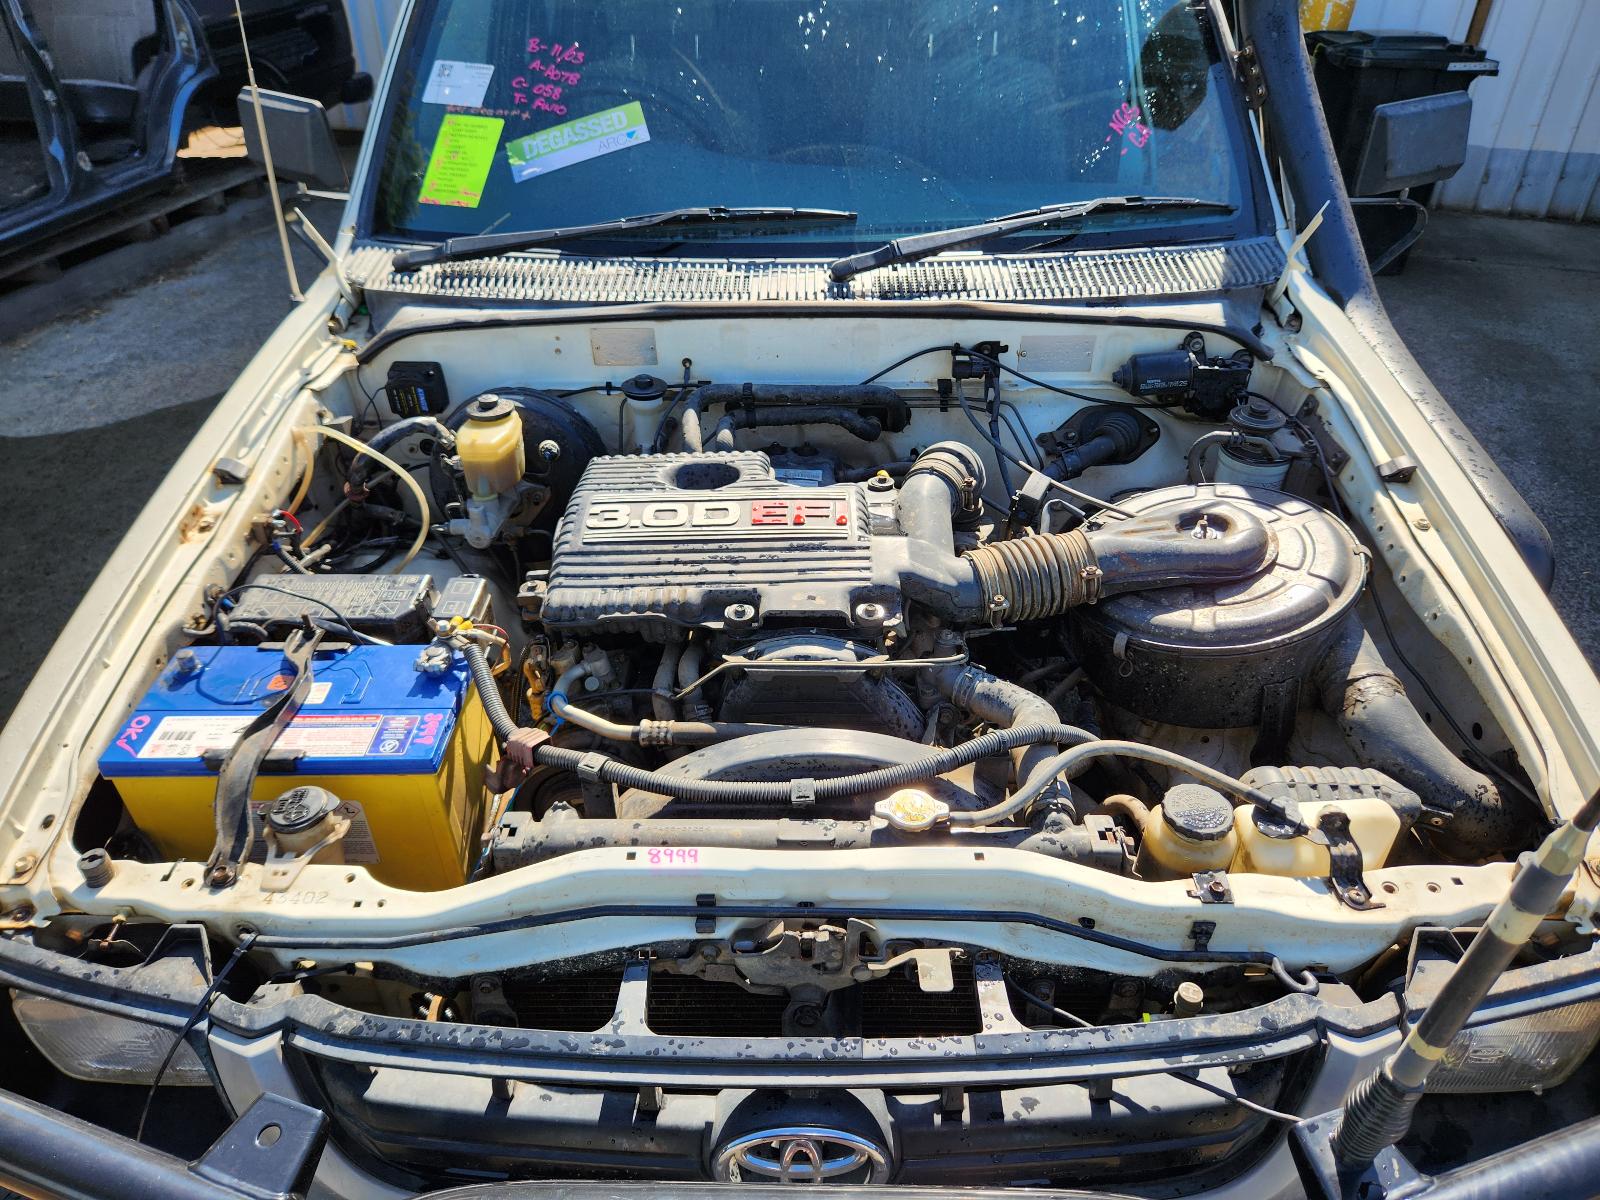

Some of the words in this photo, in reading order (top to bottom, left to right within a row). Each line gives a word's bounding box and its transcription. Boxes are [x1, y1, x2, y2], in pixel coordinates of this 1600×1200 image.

[523, 111, 628, 159] DEGASSED
[586, 502, 741, 530] 3.0D
[647, 848, 699, 864] 8999
